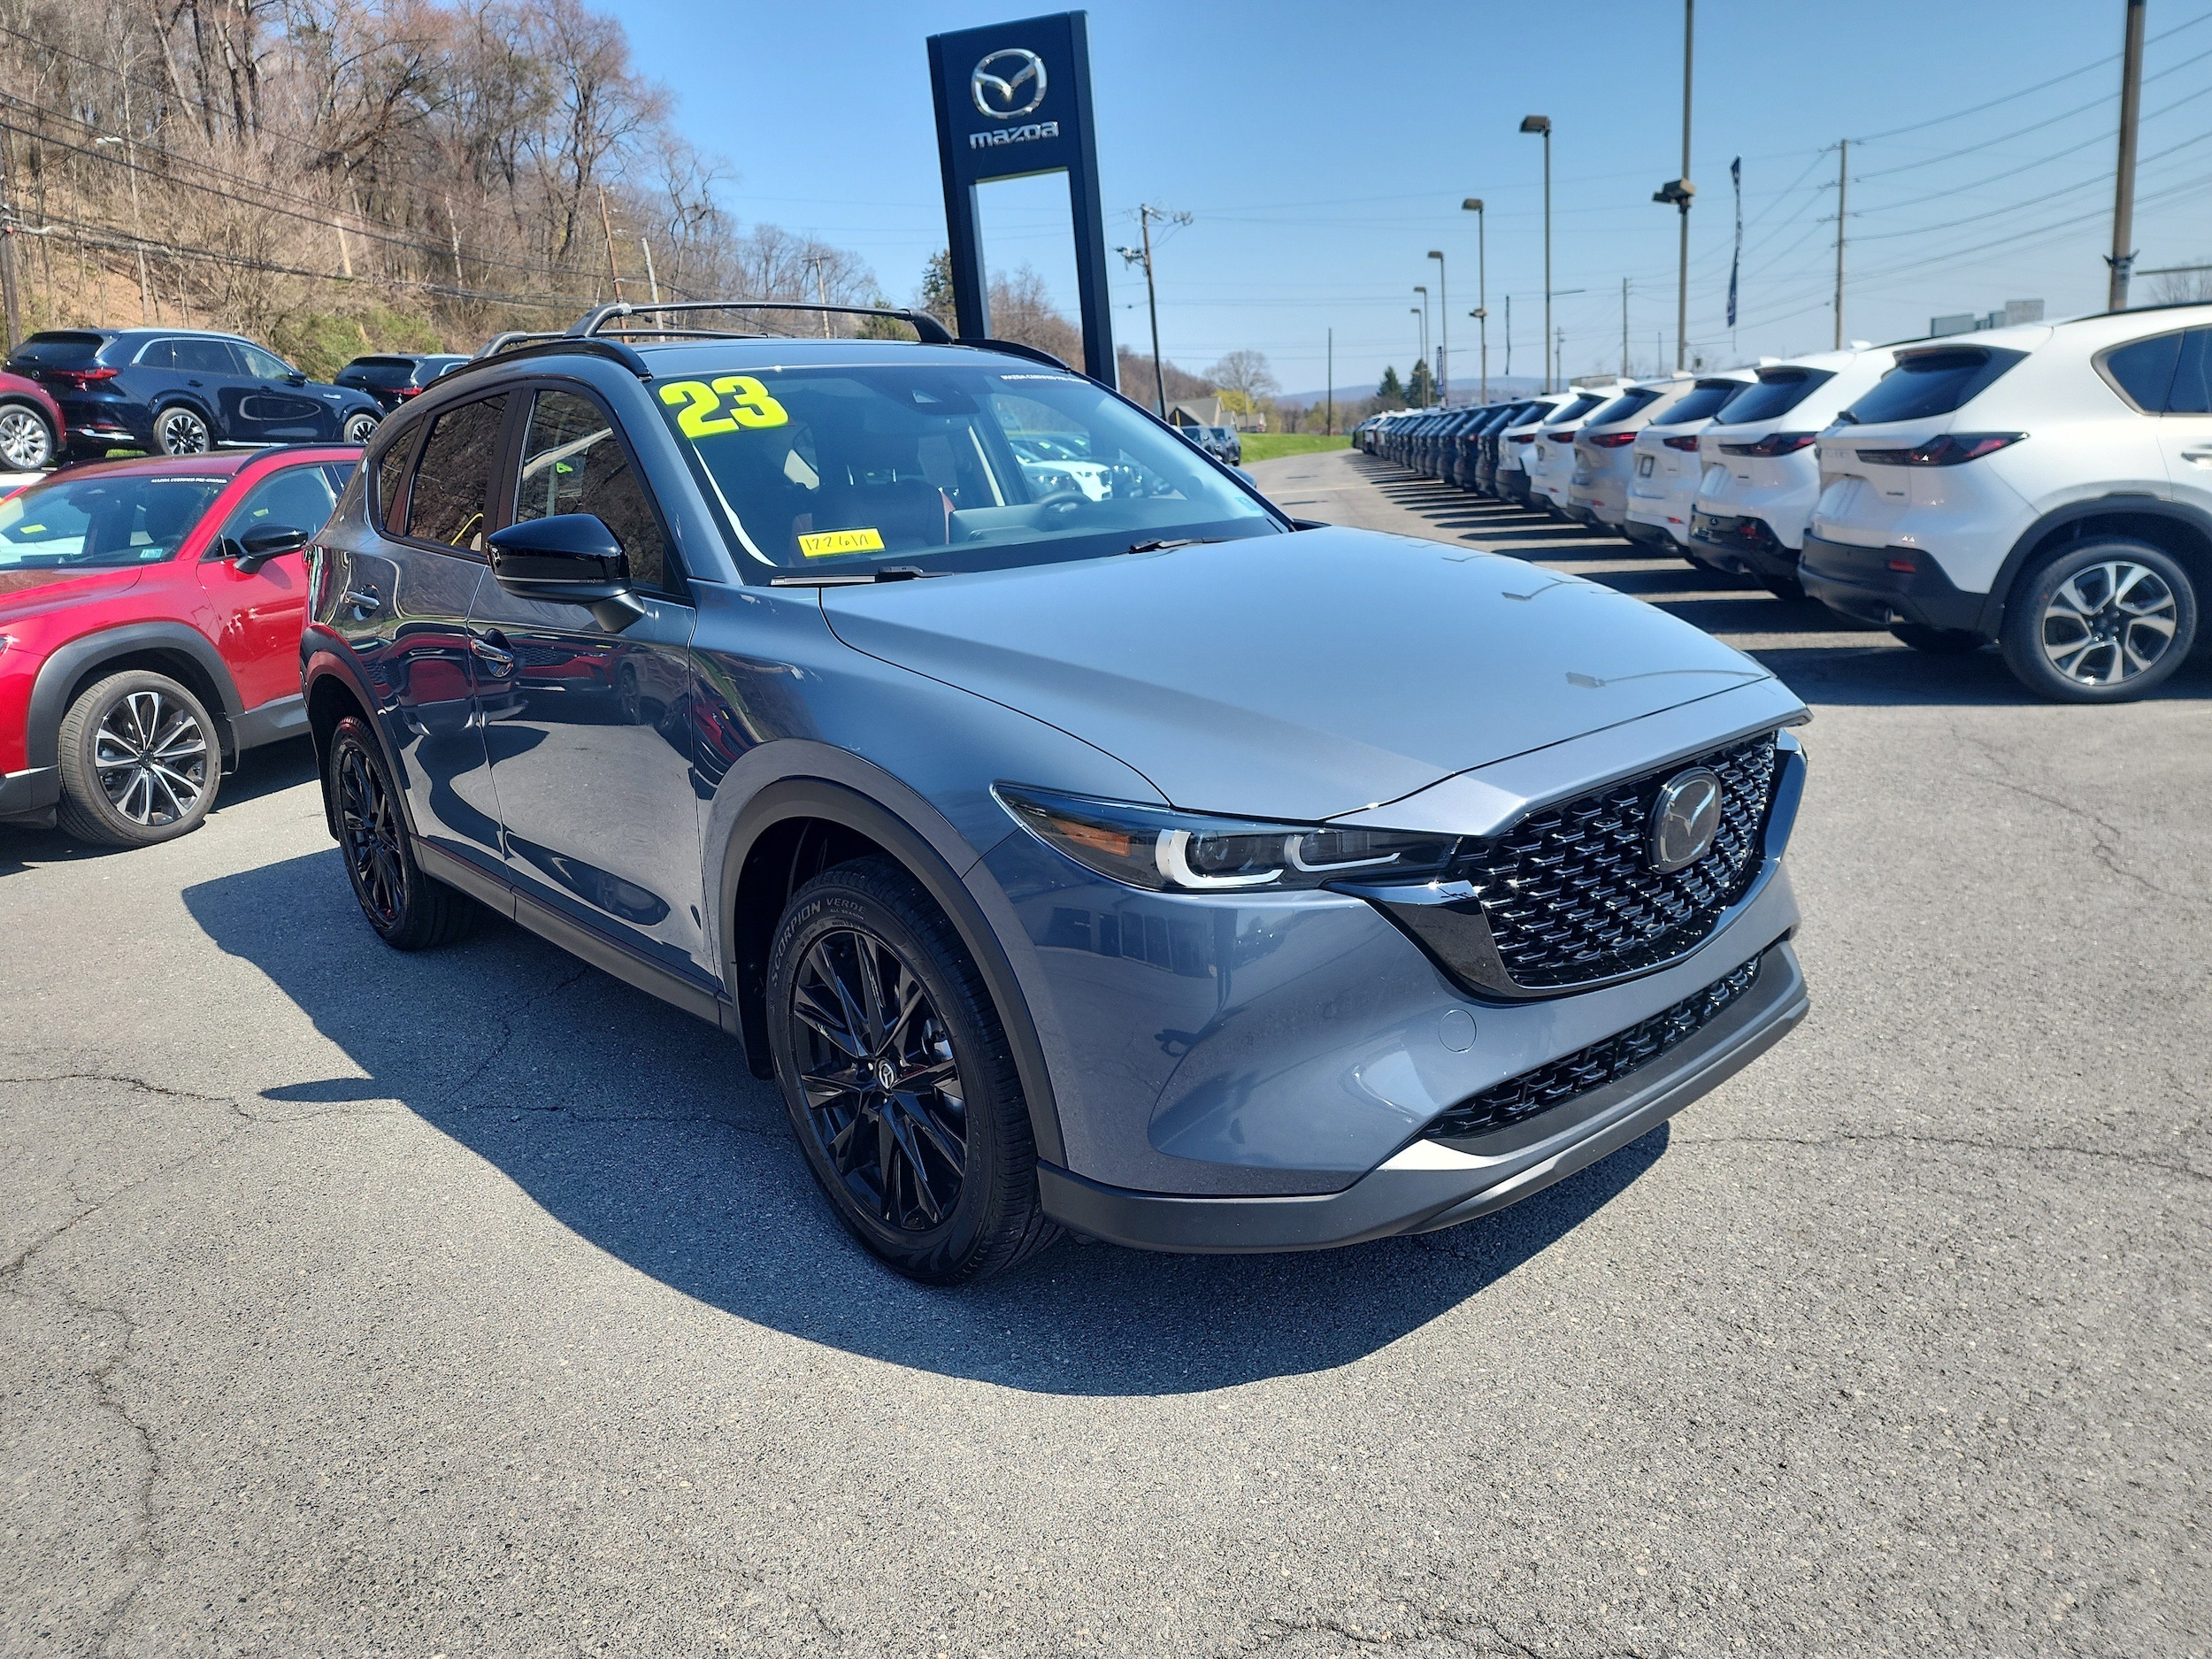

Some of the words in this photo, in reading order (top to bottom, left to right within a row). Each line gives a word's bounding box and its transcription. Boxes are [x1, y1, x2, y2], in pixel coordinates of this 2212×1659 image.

[658, 375, 789, 439] 23
[771, 900, 821, 987] SCORPION
[826, 897, 867, 915] VERDE
